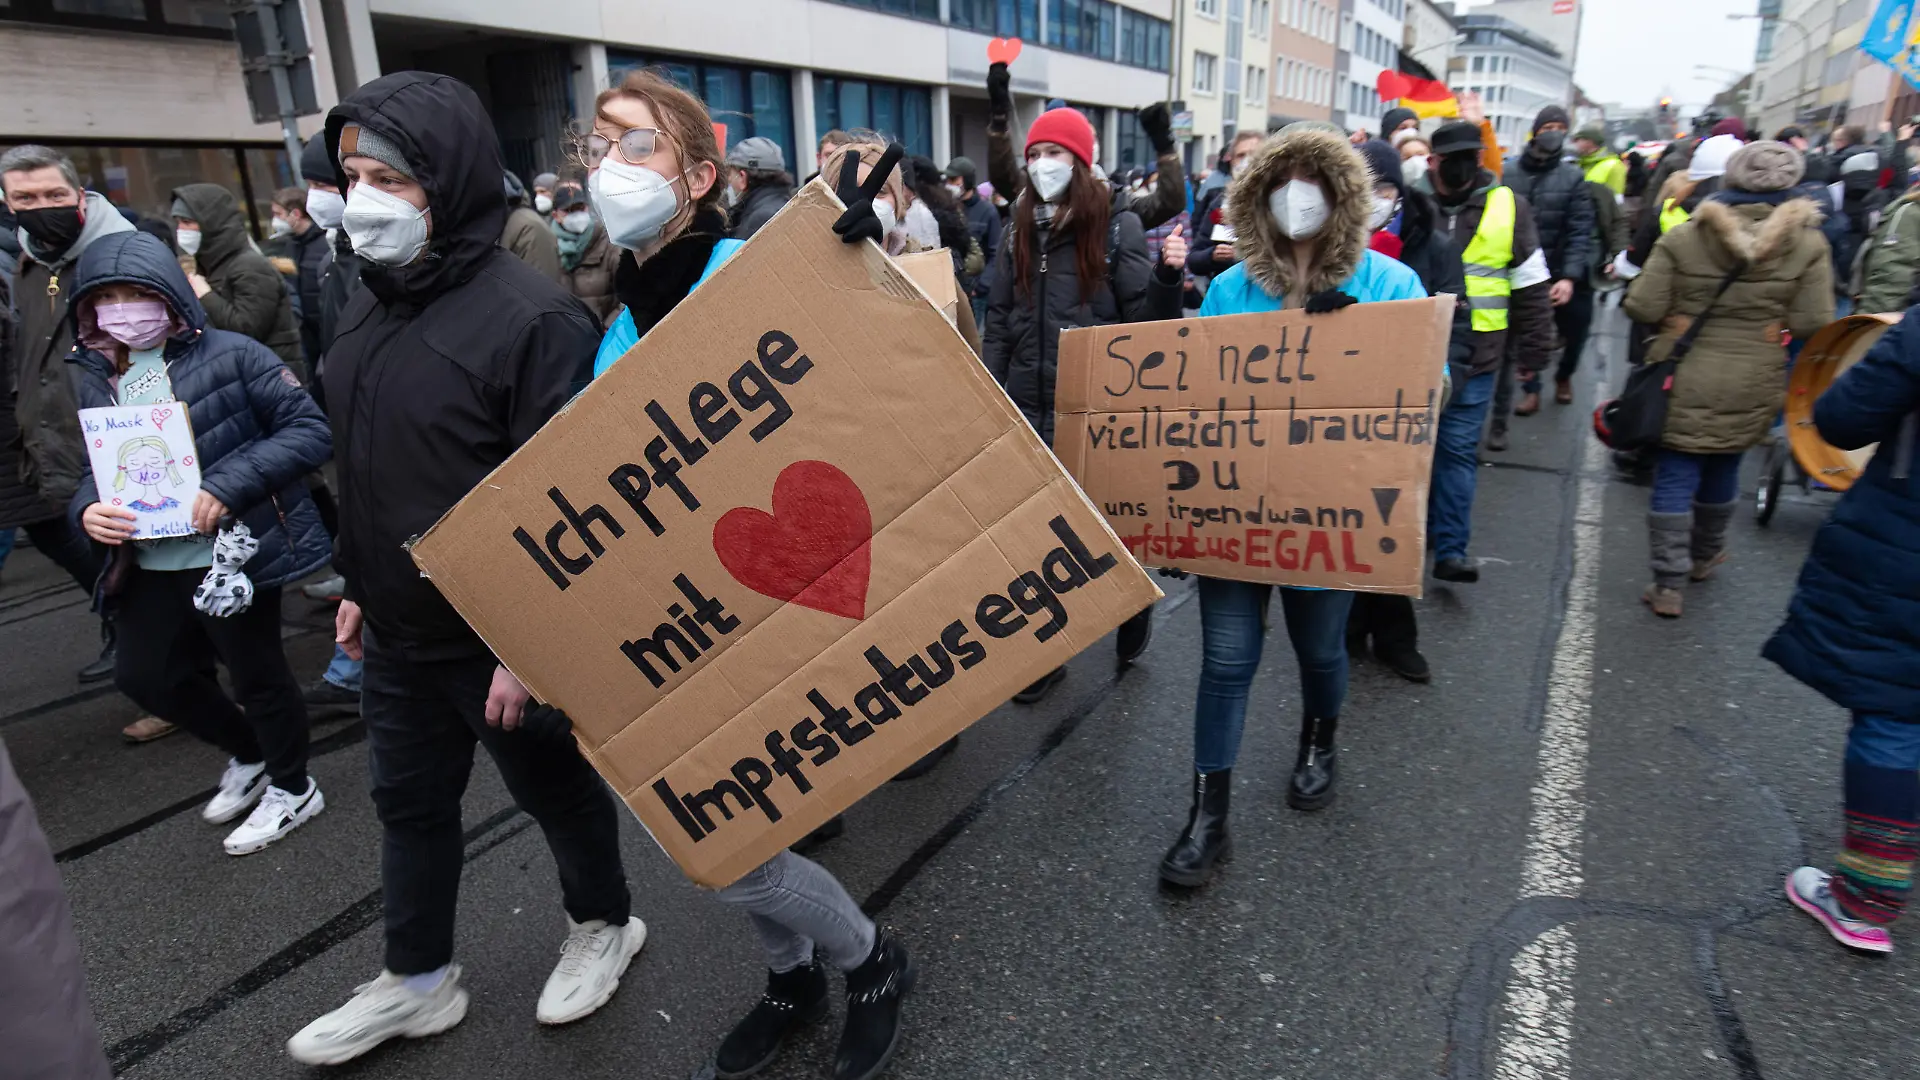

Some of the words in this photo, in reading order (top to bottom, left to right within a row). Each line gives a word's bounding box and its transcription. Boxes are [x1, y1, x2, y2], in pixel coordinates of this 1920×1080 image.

[1104, 326, 1190, 397] Sei
[1219, 325, 1316, 384] nett
[84, 419, 100, 433] No
[105, 412, 143, 432] Mask
[1088, 395, 1265, 450] vielleicht
[1288, 388, 1436, 446] brauchst
[512, 486, 626, 592] Ich
[1104, 501, 1149, 517] uns
[1167, 495, 1364, 529] irgendwann
[1371, 487, 1401, 555] !
[618, 573, 742, 689] mit
[651, 618, 987, 844] Impfstatus
